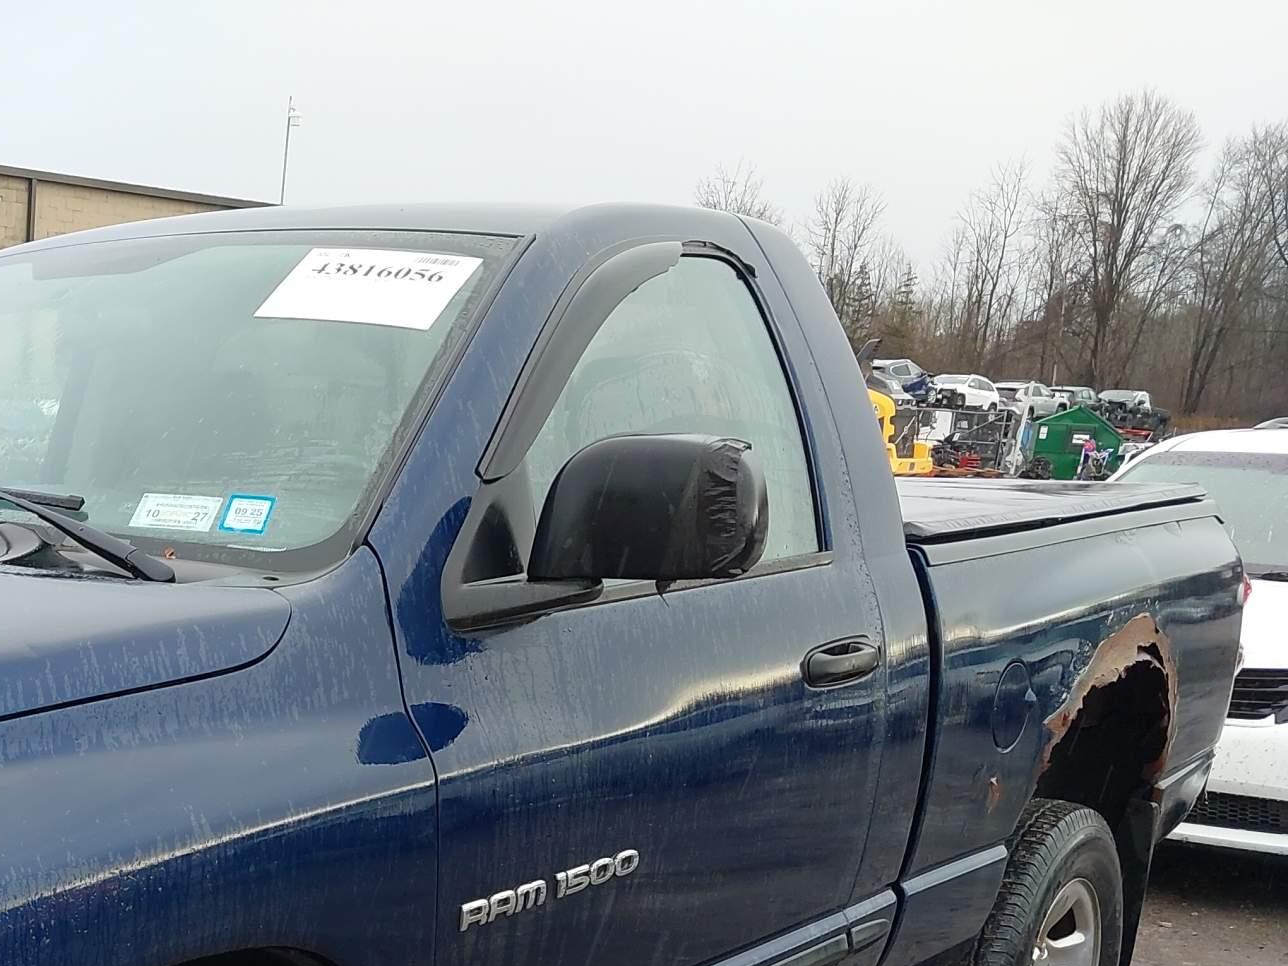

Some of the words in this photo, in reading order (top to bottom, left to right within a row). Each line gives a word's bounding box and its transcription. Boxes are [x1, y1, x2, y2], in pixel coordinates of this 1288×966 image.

[312, 261, 444, 283] 43816056
[145, 508, 160, 518] 10
[190, 511, 209, 522] 27
[459, 879, 547, 932] RAM
[554, 848, 640, 899] 1500
